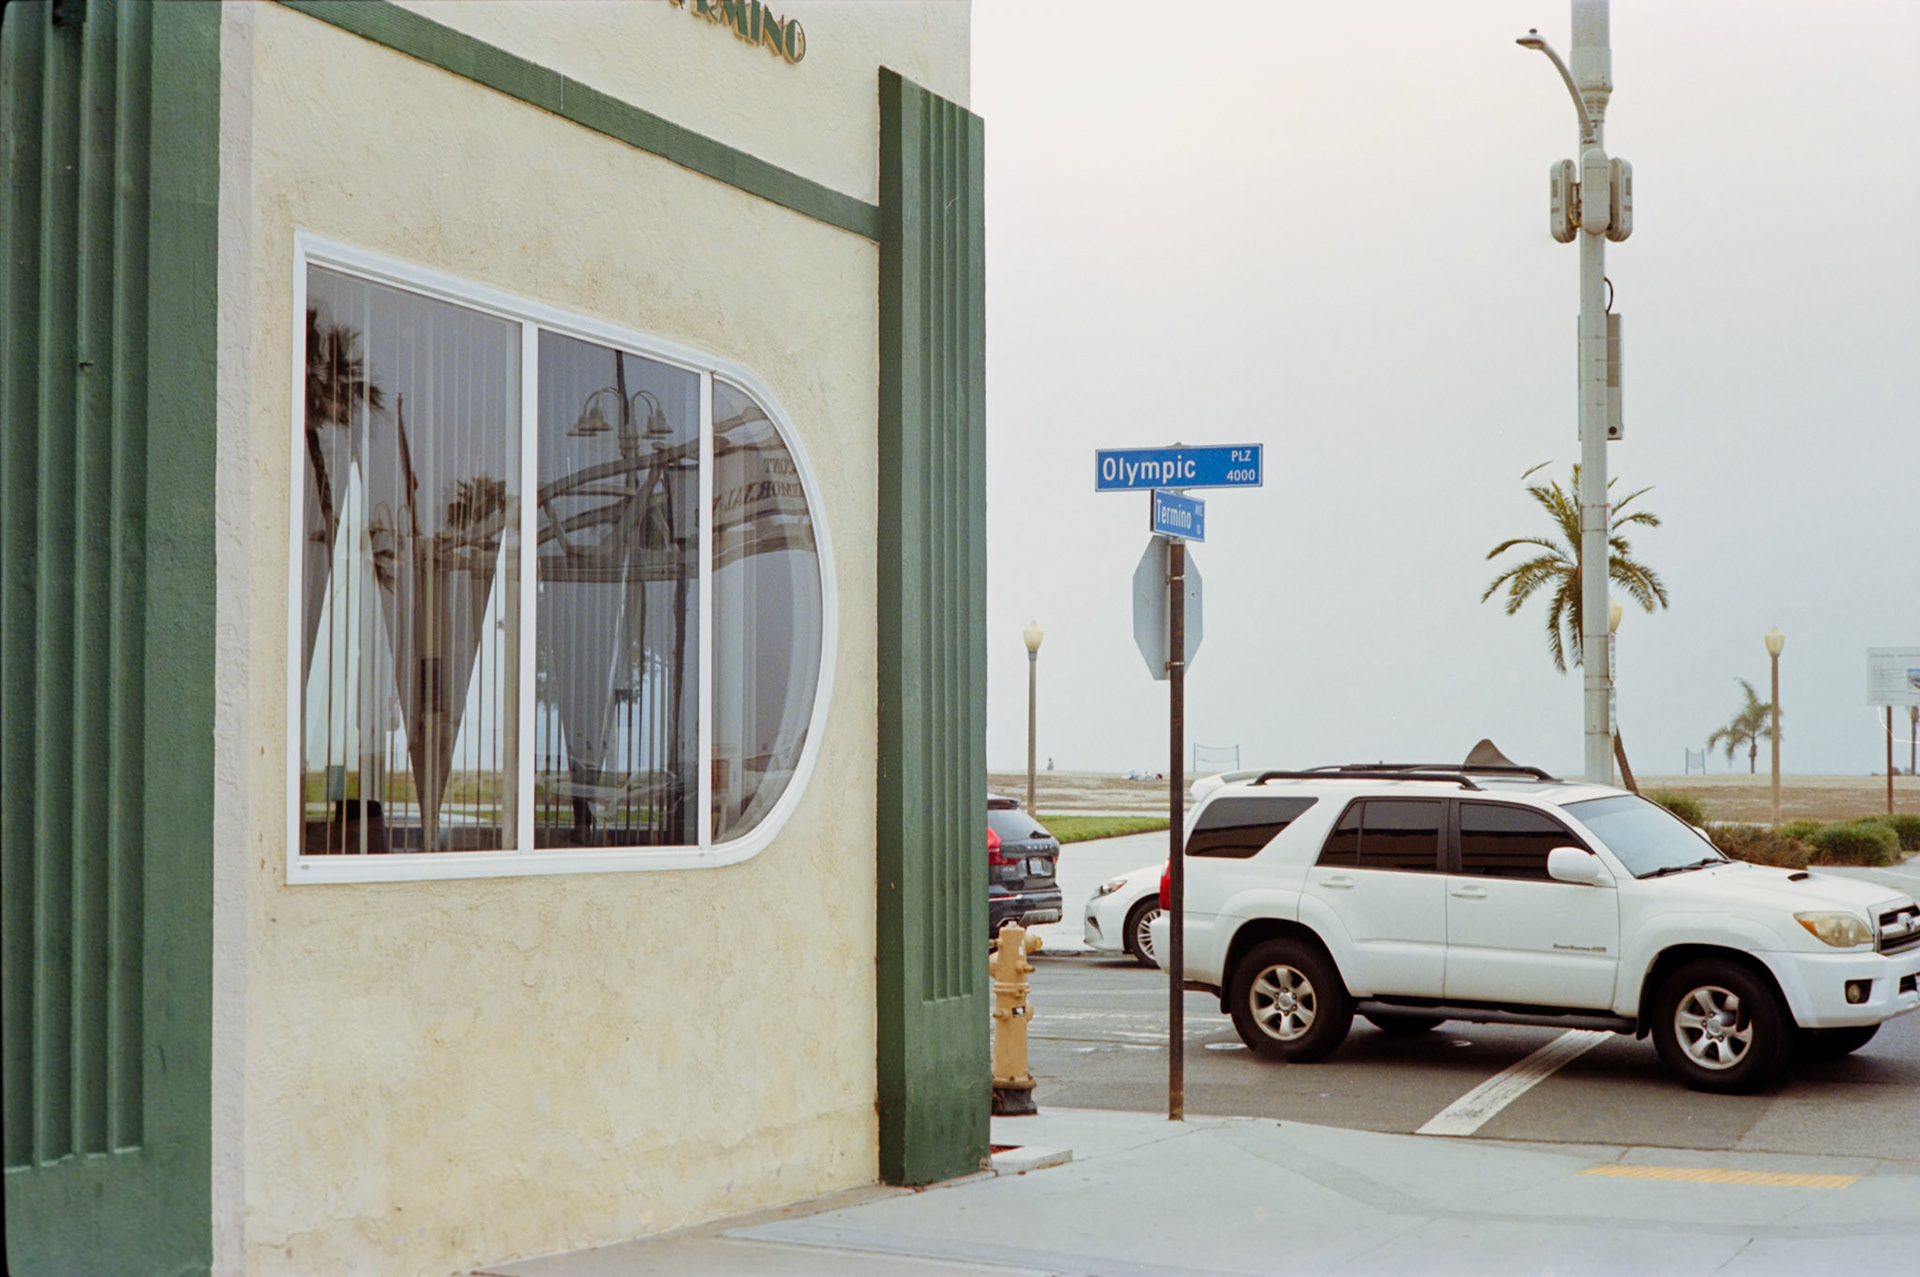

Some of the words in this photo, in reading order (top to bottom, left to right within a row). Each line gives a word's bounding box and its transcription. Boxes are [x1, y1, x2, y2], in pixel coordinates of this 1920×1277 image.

[1102, 455, 1196, 486] Olympic
[1231, 450, 1252, 463] PLZ
[1226, 469, 1256, 482] 4000
[1156, 499, 1192, 530] Termino
